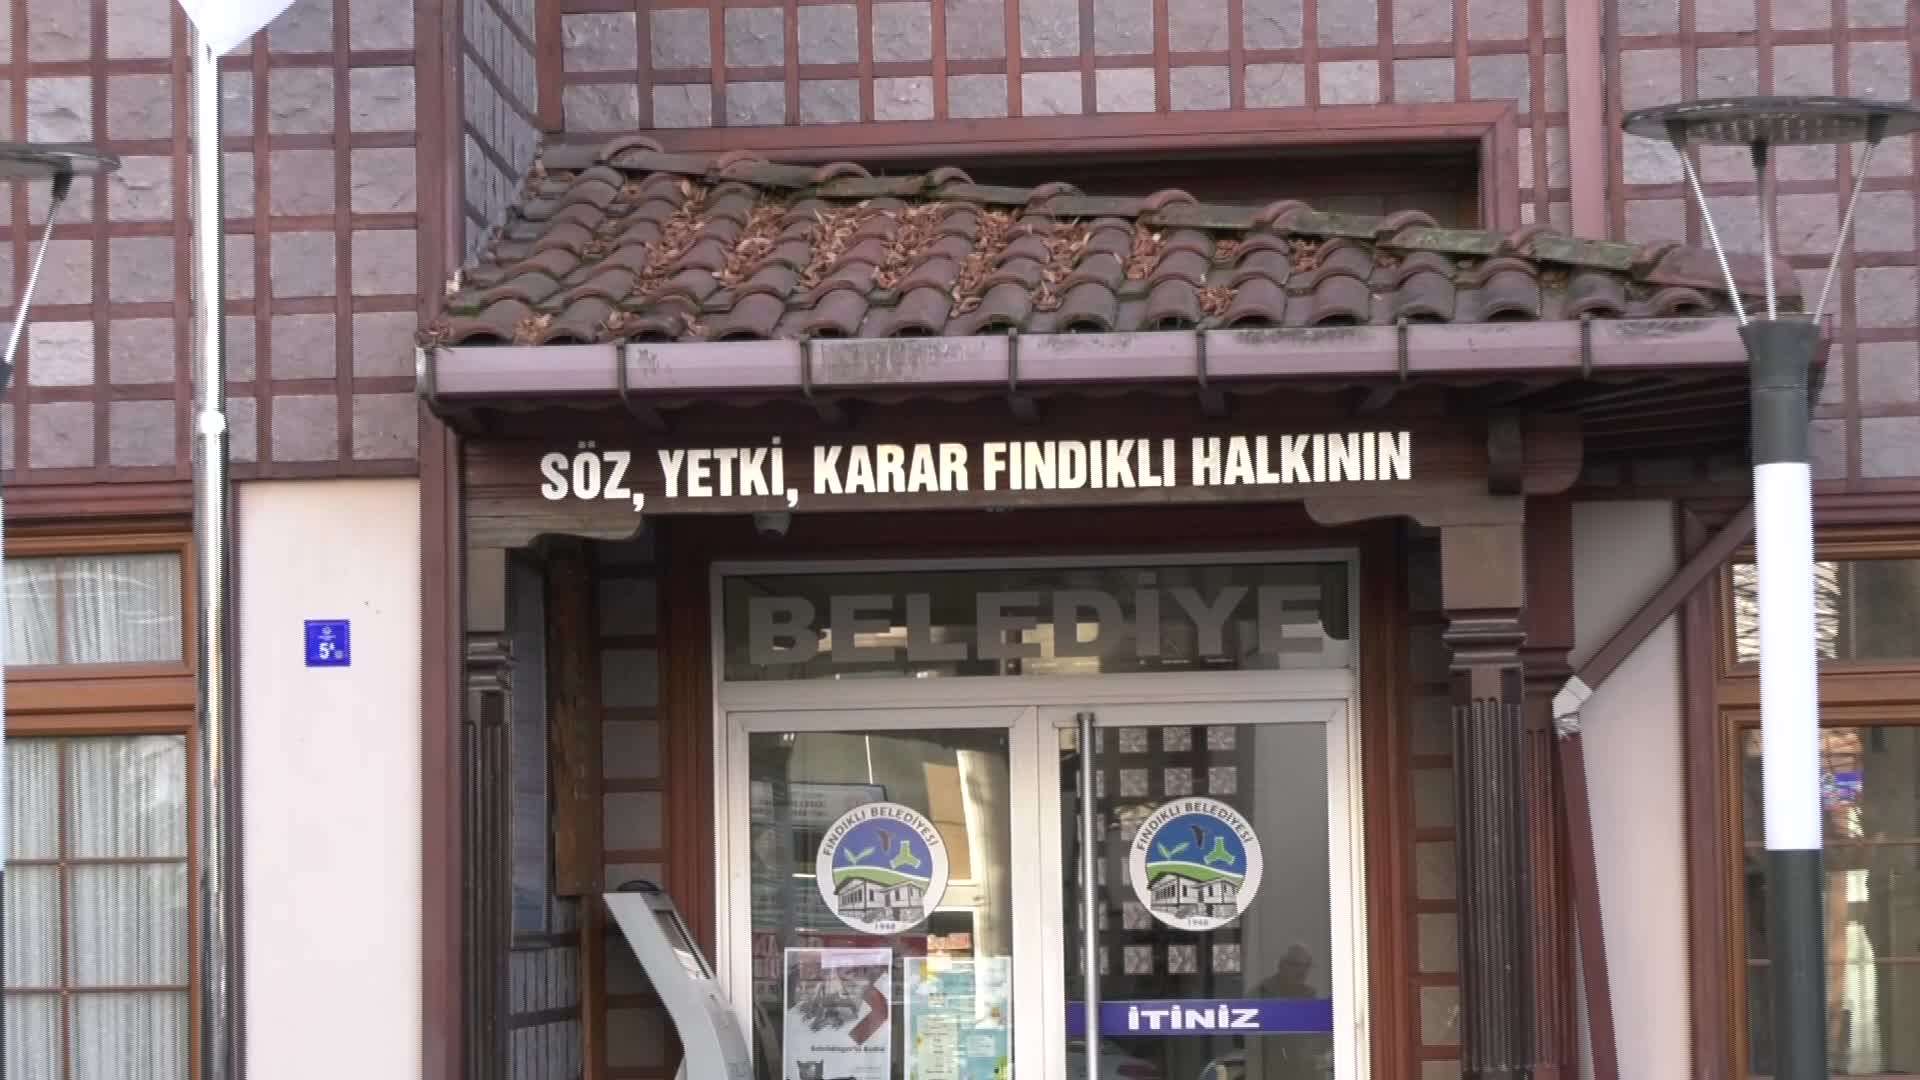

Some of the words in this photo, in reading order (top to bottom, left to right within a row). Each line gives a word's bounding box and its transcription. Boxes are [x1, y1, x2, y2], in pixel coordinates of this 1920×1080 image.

[540, 440, 645, 512] SÖZ,
[657, 436, 799, 508] YETKİ,
[812, 442, 969, 495] KARAR
[982, 438, 1176, 491] FINDIKLI
[1191, 431, 1412, 486] HALKININ
[748, 571, 1325, 665] BELEDİYE
[823, 810, 867, 857] FINDIKLI
[870, 806, 940, 847] BELEDİYESİ
[1137, 805, 1181, 851] FINDIKLI
[1184, 802, 1254, 843] BELEDİYESİ
[1128, 1004, 1260, 1030] İTİNİZ
